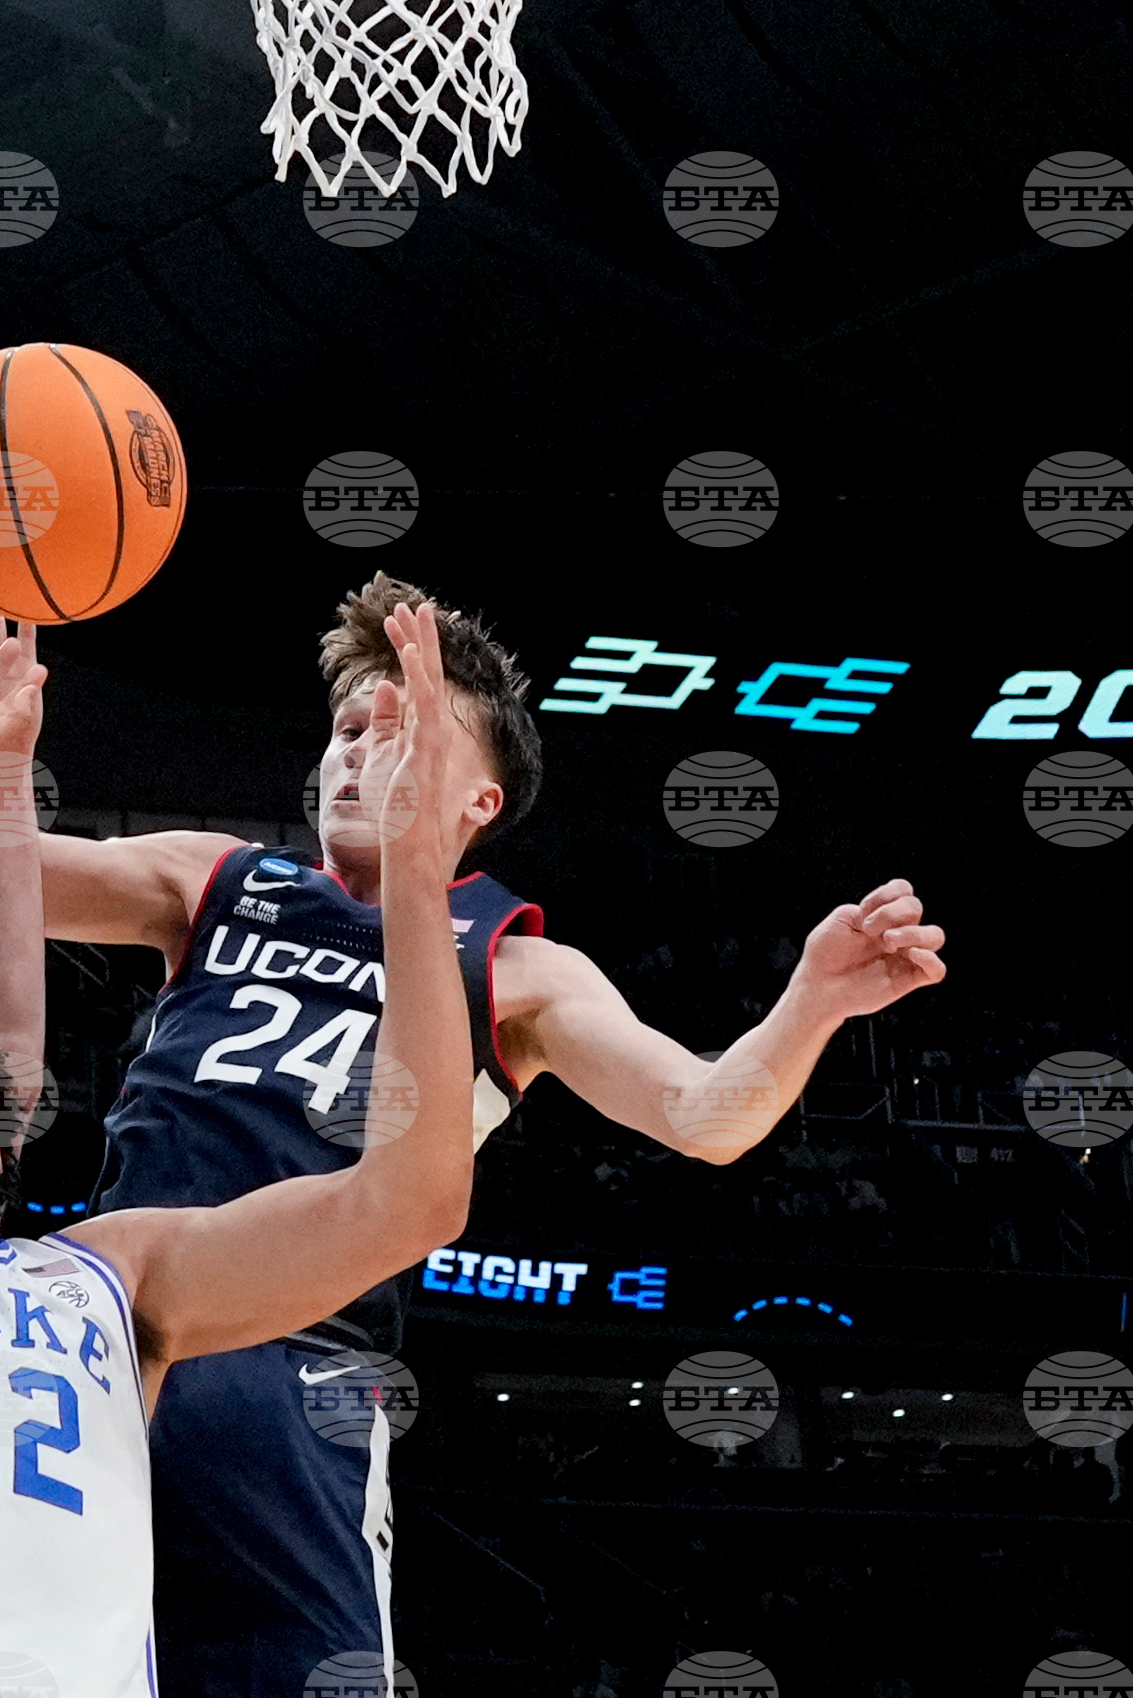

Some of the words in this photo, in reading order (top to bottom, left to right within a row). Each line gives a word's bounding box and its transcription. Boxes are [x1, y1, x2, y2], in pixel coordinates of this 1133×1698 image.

[233, 904, 280, 925] CHANGE
[239, 896, 258, 909] BE
[257, 900, 281, 915] THE
[193, 984, 378, 1115] 24
[422, 1248, 589, 1306] EIGHT
